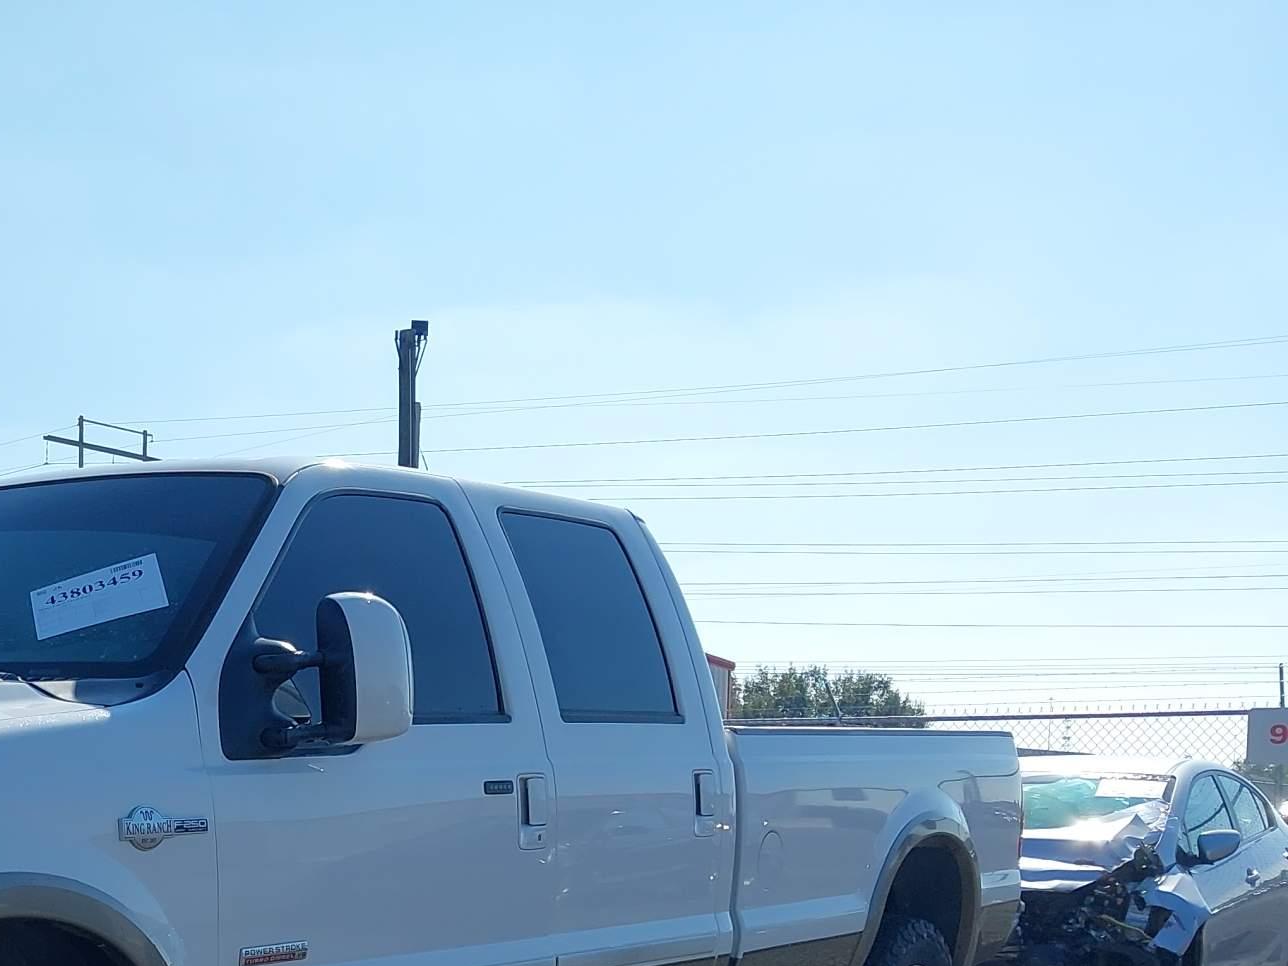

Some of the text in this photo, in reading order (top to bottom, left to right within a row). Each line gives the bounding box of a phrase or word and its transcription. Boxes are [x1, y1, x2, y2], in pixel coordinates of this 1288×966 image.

[45, 569, 145, 605] 43803459
[1269, 724, 1288, 745] 9
[125, 819, 172, 836] KING RANCH
